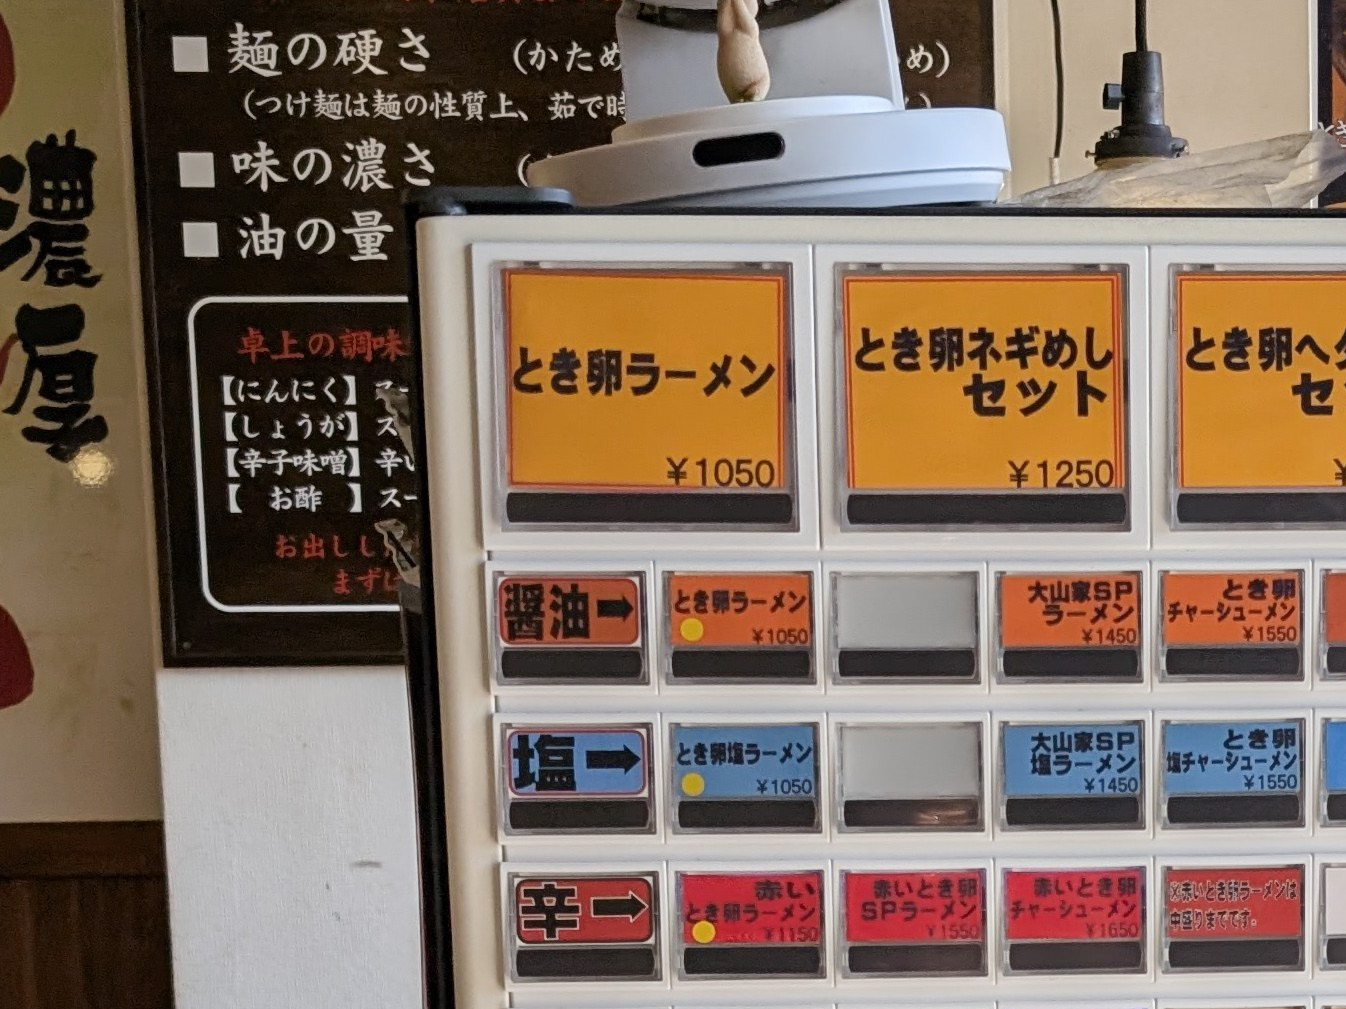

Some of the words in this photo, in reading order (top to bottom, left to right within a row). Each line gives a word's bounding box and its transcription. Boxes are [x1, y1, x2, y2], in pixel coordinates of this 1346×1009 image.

[227, 22, 432, 77] 麺の硬さ
[232, 139, 436, 191] 味の濃さ
[239, 210, 393, 261] 油の量
[854, 326, 1113, 372] とき卵ネギめし
[513, 346, 775, 397] とき卵ラーメン
[964, 372, 1107, 417] セット
[666, 457, 775, 488] ¥1050
[1008, 460, 1114, 489] ¥1250
[1028, 581, 1134, 603] 大山家SP
[1222, 579, 1296, 601] とき卵
[504, 583, 591, 641] 醤油
[674, 589, 807, 615] とき卵ラーメン
[1042, 604, 1134, 626] ラーメン
[1167, 604, 1295, 623] チャーシューメン
[752, 628, 808, 645] ¥1050
[1082, 629, 1137, 644] ¥1450
[1242, 626, 1297, 642] ¥1550
[1030, 732, 1134, 753] 大山家SP
[1224, 729, 1296, 750] とき卵
[512, 734, 577, 792] 塩
[677, 742, 812, 766] とき卵塩ラーメン
[1030, 754, 1136, 775] 塩ラーメン
[1167, 751, 1297, 773] 塩チャーシューメン
[756, 778, 812, 795] ¥1050
[1084, 778, 1138, 793] ¥1450
[1244, 774, 1297, 790] ¥1550
[1034, 877, 1137, 897] 赤いとき卵
[522, 883, 581, 939] 辛
[687, 903, 816, 923] とき卵ラーメン
[861, 902, 976, 920] SPラーメン
[1011, 899, 1137, 920] チャーシューメン
